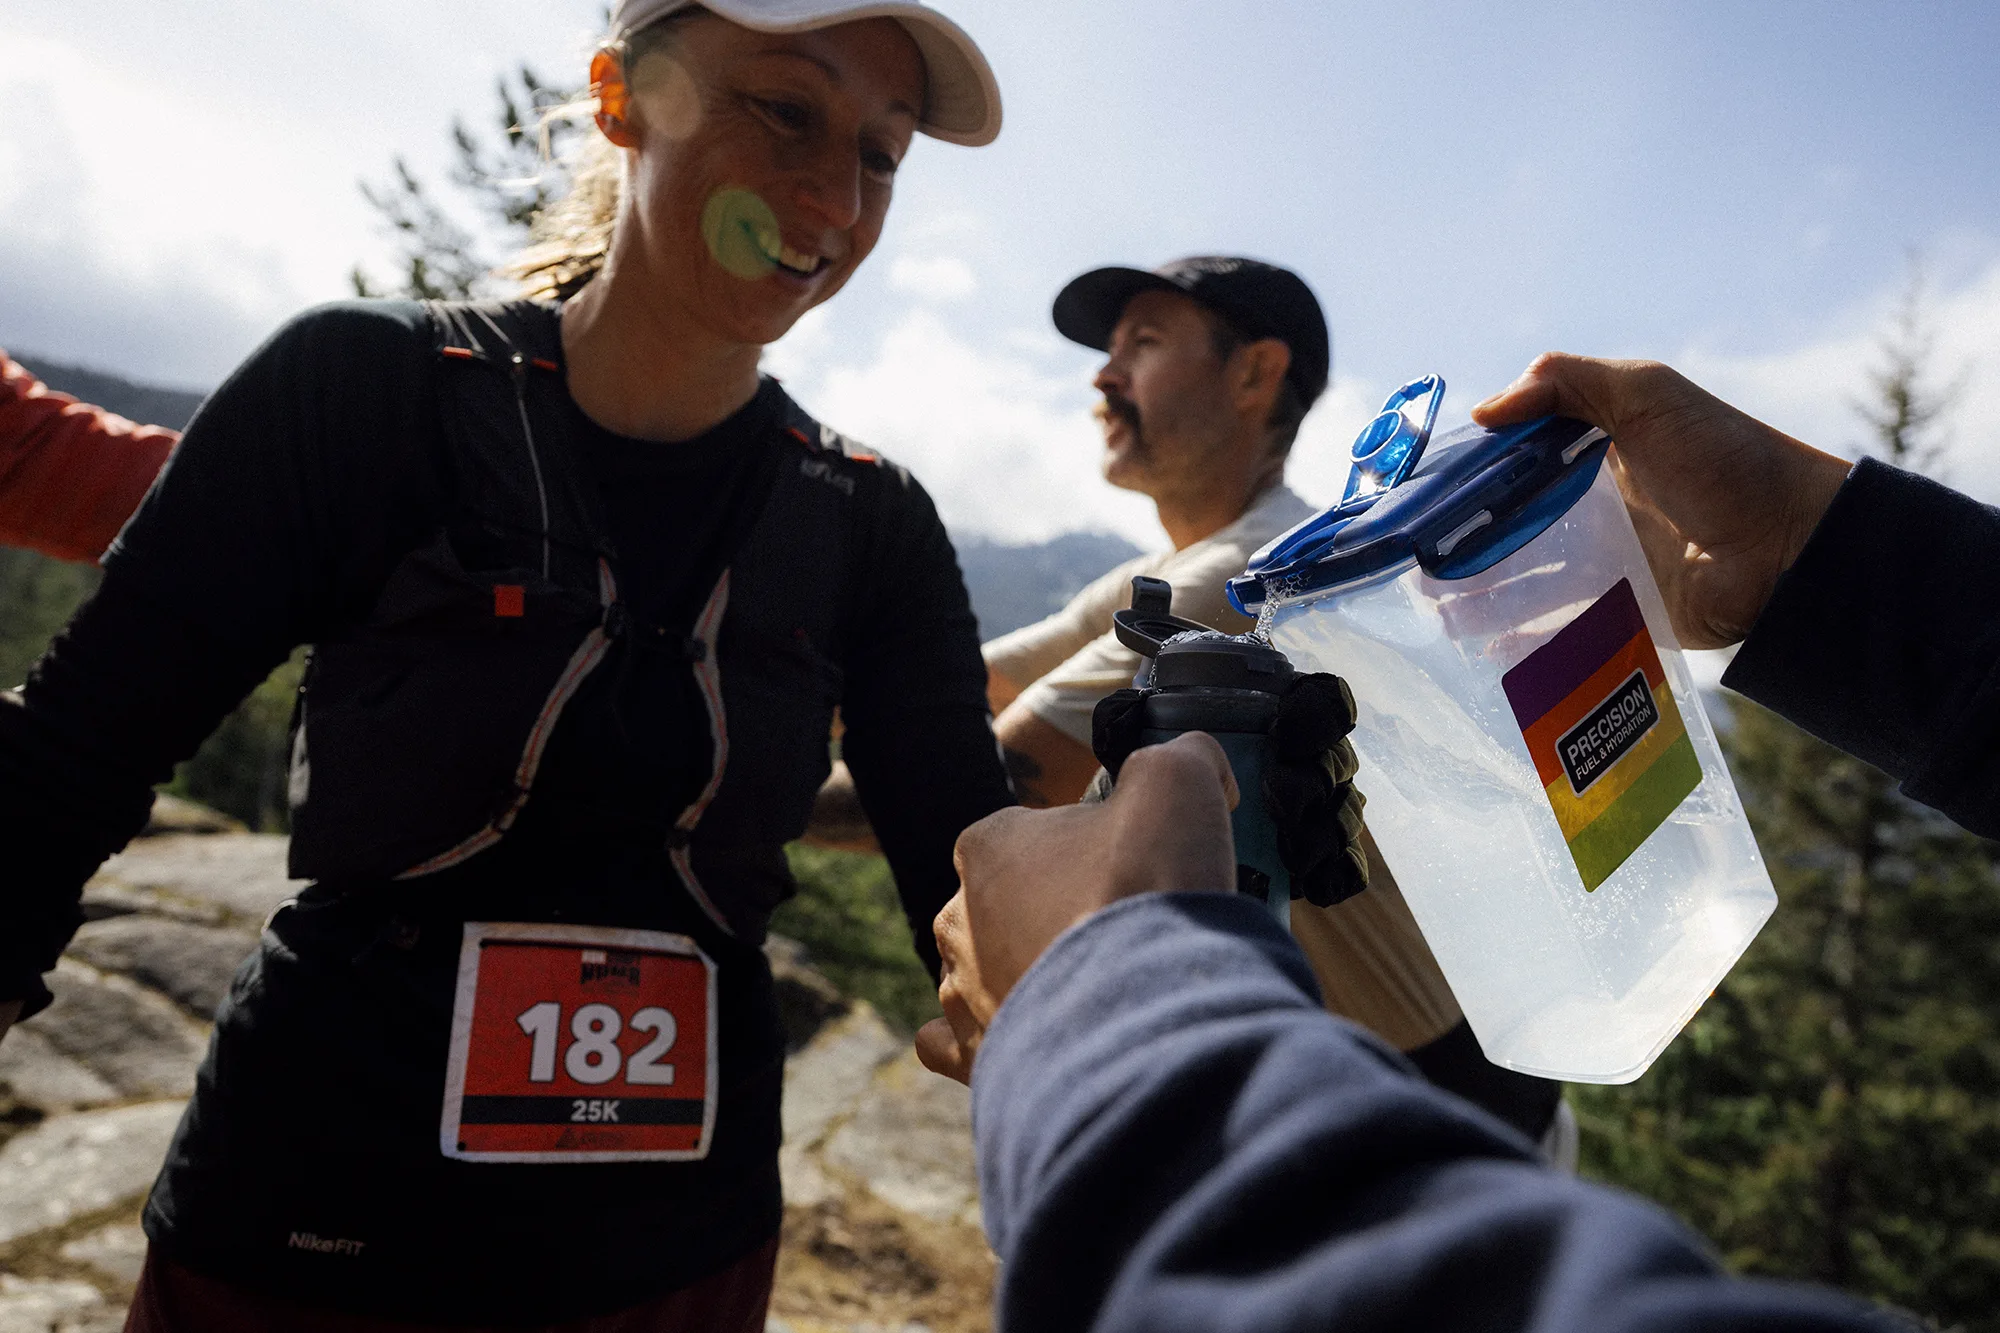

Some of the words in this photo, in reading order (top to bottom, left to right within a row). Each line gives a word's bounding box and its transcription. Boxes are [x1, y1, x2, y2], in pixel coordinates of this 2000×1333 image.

[1567, 684, 1646, 766] PRECISION
[1575, 755, 1601, 781] FUEL
[1599, 747, 1608, 760] &
[1605, 705, 1651, 753] HYDRATION
[516, 1001, 678, 1086] 182
[570, 1100, 620, 1122] 25K
